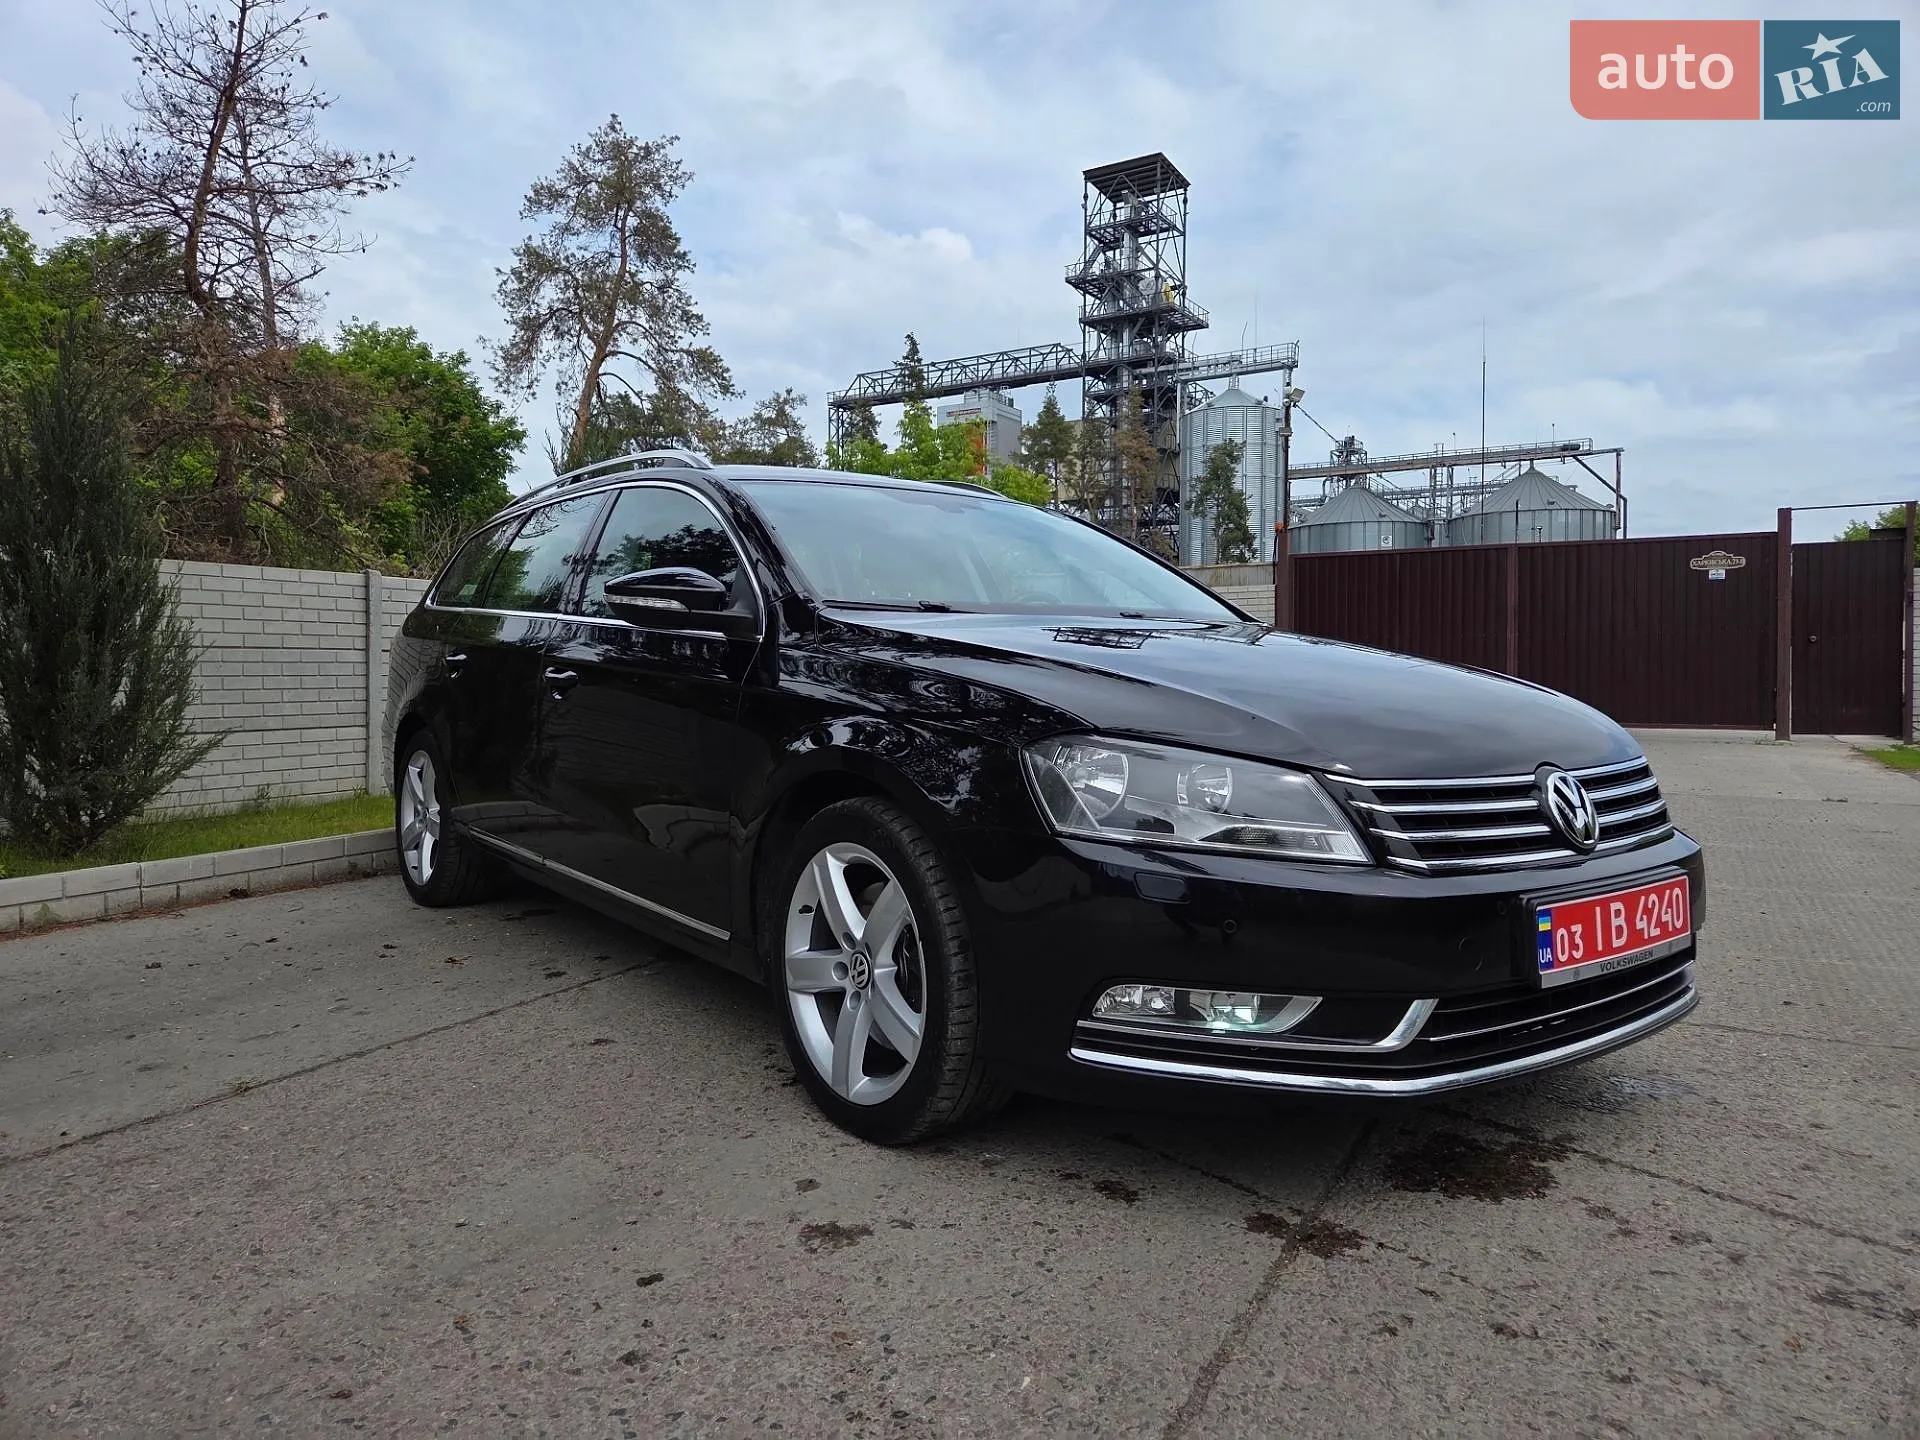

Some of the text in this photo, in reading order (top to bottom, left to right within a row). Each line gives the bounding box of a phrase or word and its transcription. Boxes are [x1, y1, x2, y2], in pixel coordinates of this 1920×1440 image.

[1556, 923, 1584, 962] 03
[1635, 887, 1684, 940] 4240
[1539, 948, 1553, 963] UA
[1600, 950, 1655, 973] VOLKSWAGEN
